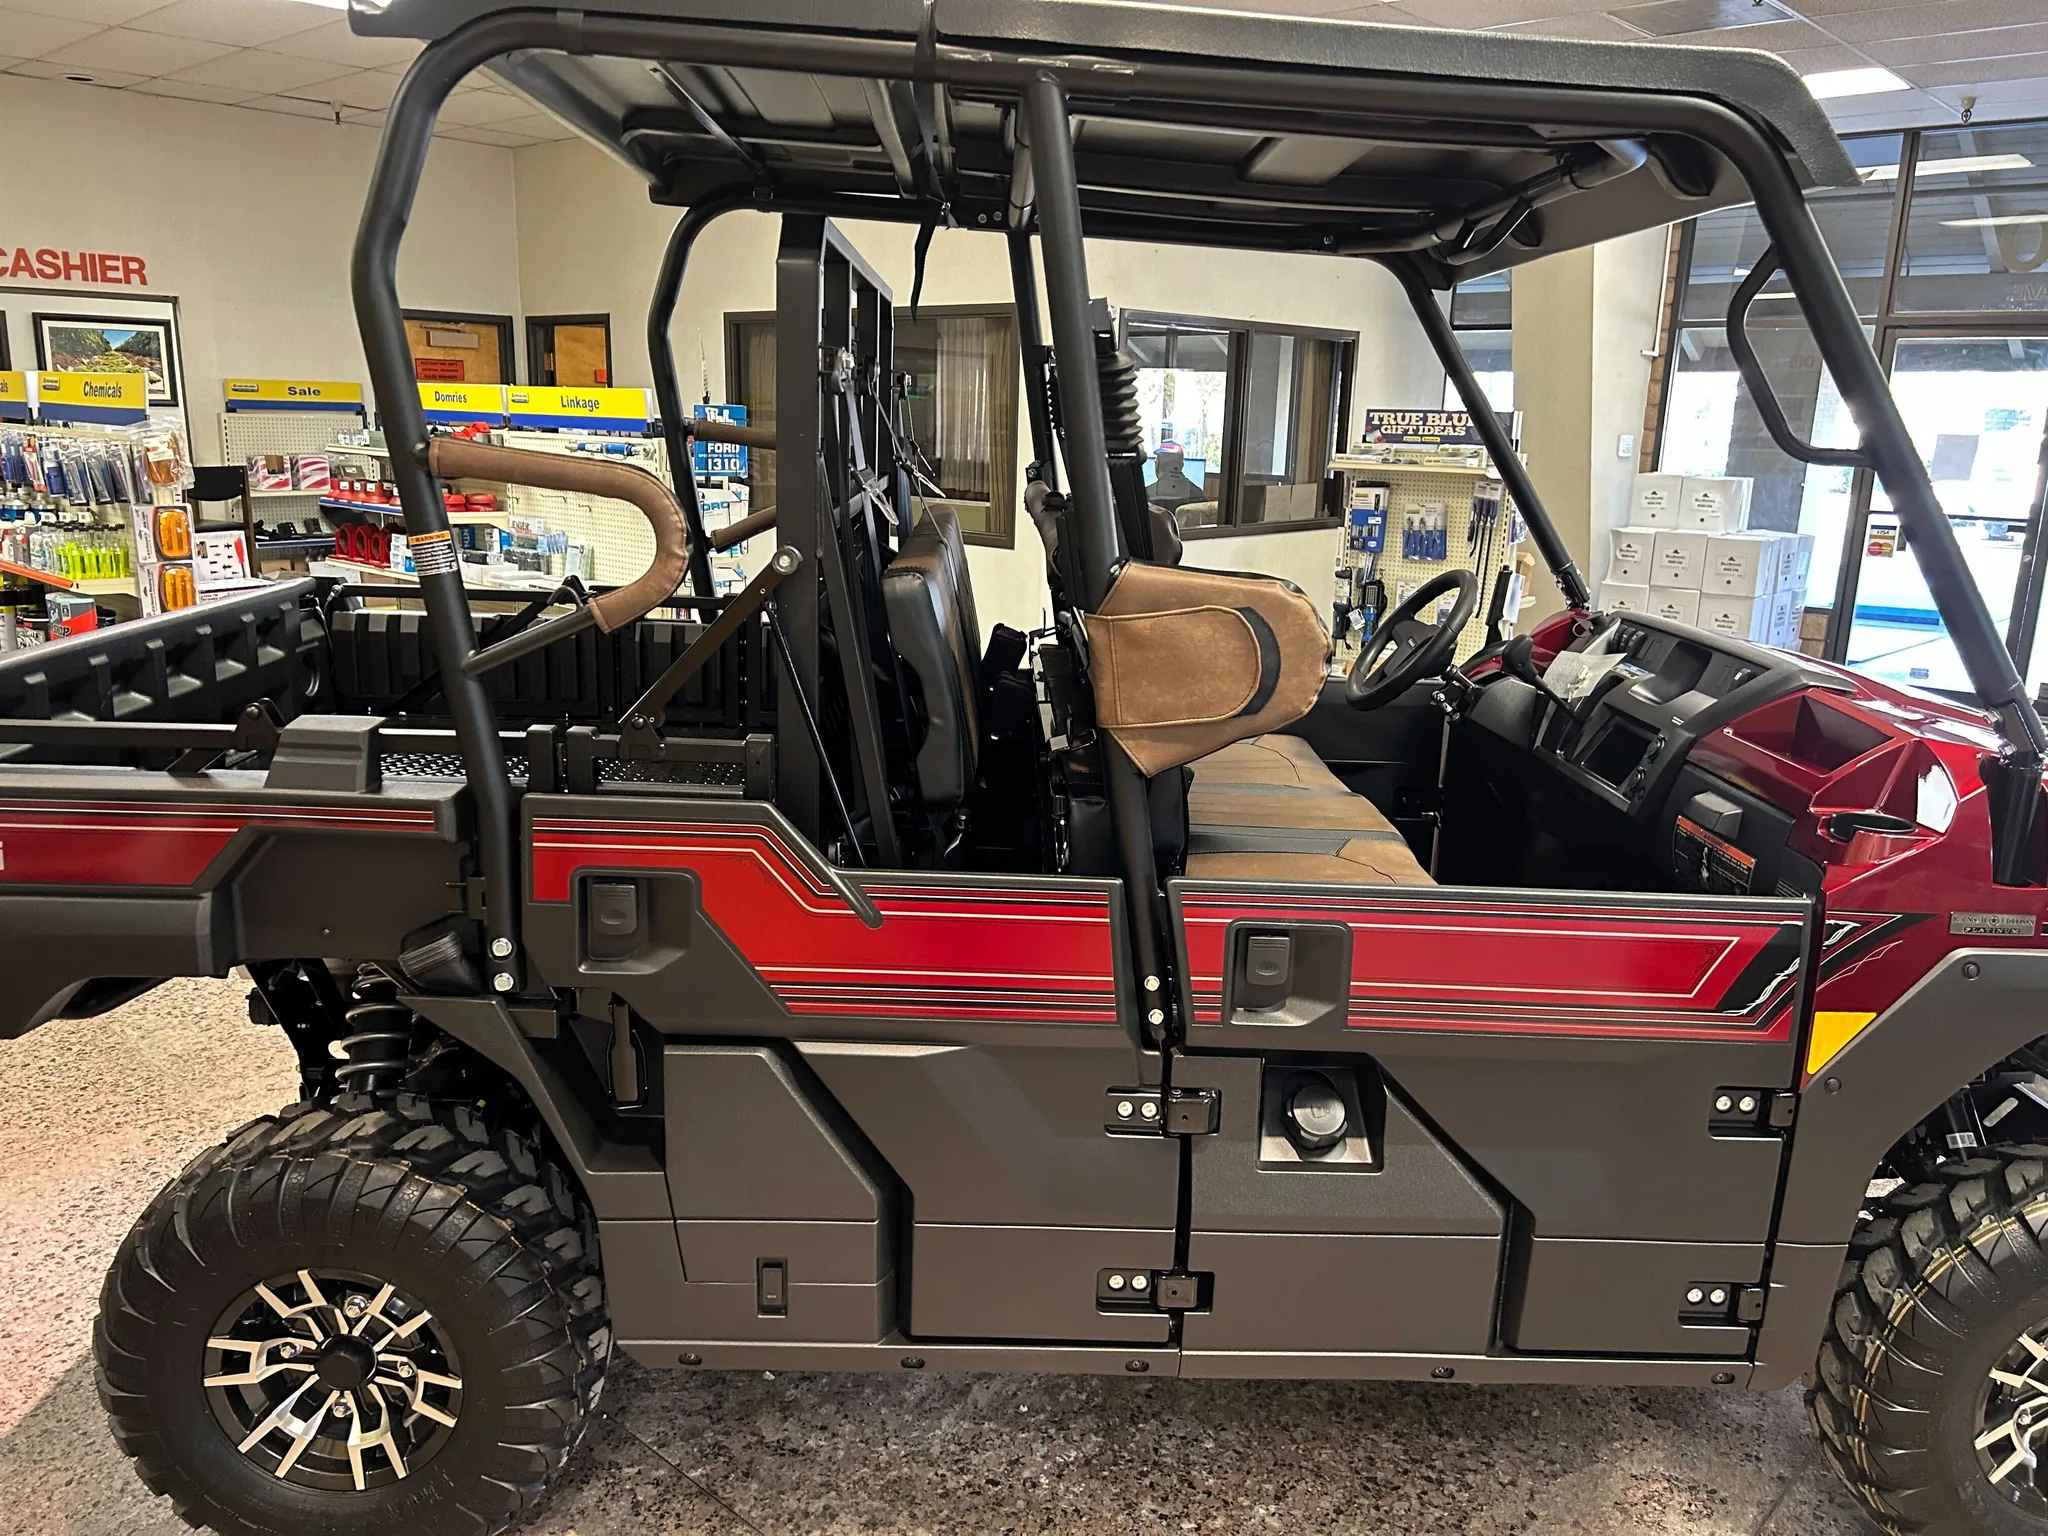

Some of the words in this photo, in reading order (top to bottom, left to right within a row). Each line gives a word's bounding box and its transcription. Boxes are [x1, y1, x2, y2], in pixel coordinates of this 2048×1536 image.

[83, 380, 122, 398] Chemicals
[287, 386, 321, 396] Sale
[434, 391, 467, 403] Domries
[560, 395, 600, 412] Linkage
[1369, 412, 1423, 425] TRUE
[1380, 425, 1417, 435] GIFT
[1418, 425, 1466, 436] IDEAS
[707, 442, 740, 453] FORD
[707, 458, 740, 471] 1310
[415, 533, 445, 543] WARNING
[462, 528, 470, 547] NTN
[1953, 916, 1987, 924] RANCH
[2001, 917, 2034, 926] EDITION
